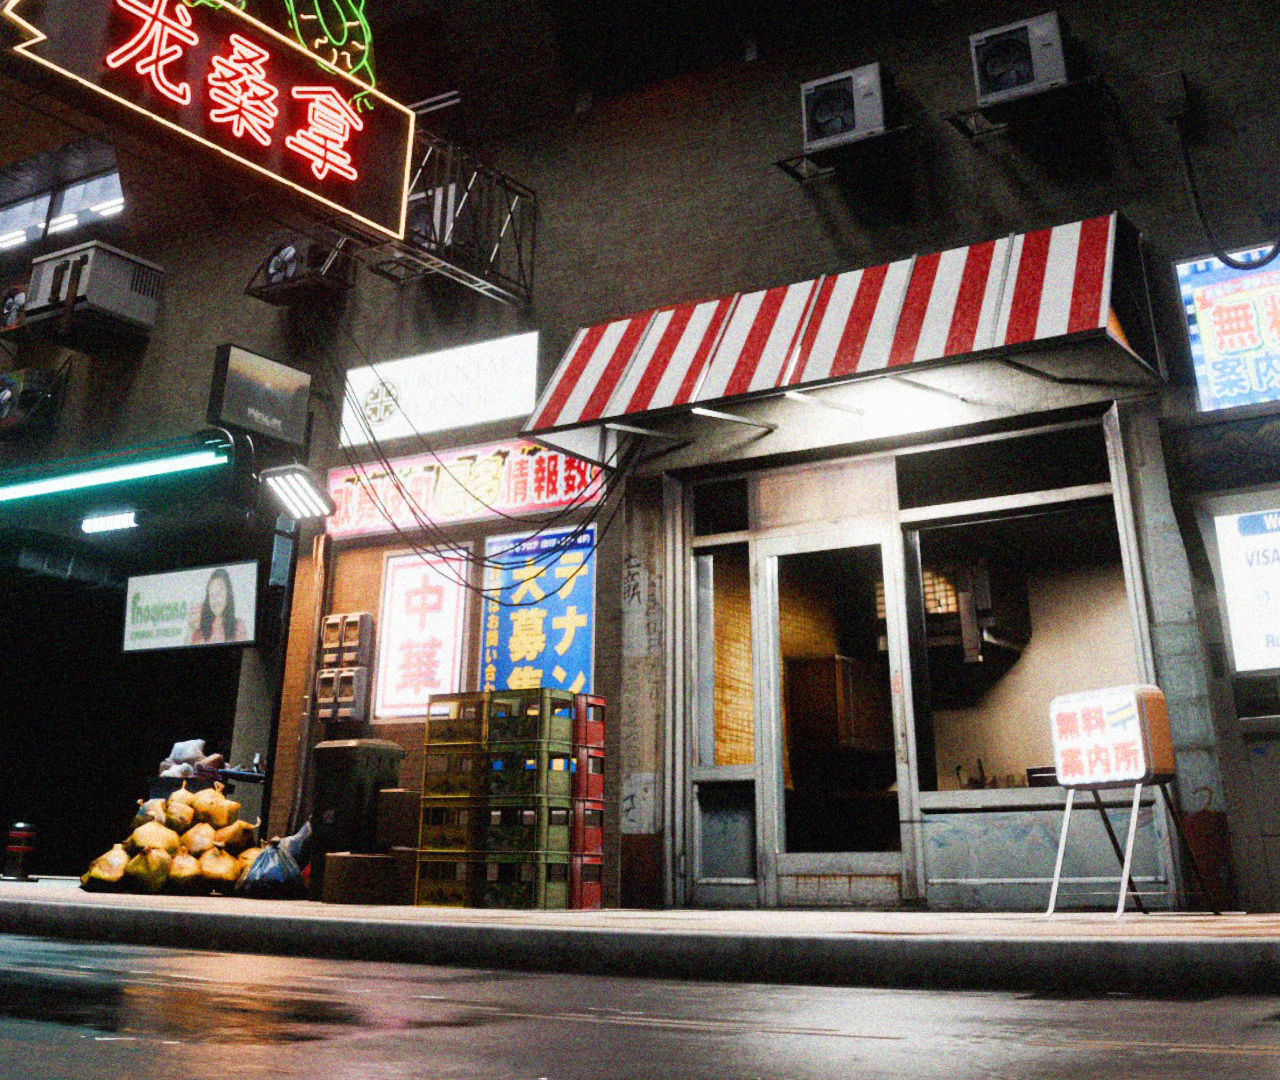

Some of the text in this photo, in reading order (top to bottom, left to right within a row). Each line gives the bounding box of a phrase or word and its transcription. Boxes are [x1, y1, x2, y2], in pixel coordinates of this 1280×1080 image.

[1245, 547, 1280, 568] VISA
[396, 572, 444, 695] 中華
[1060, 740, 1140, 778] 案内所
